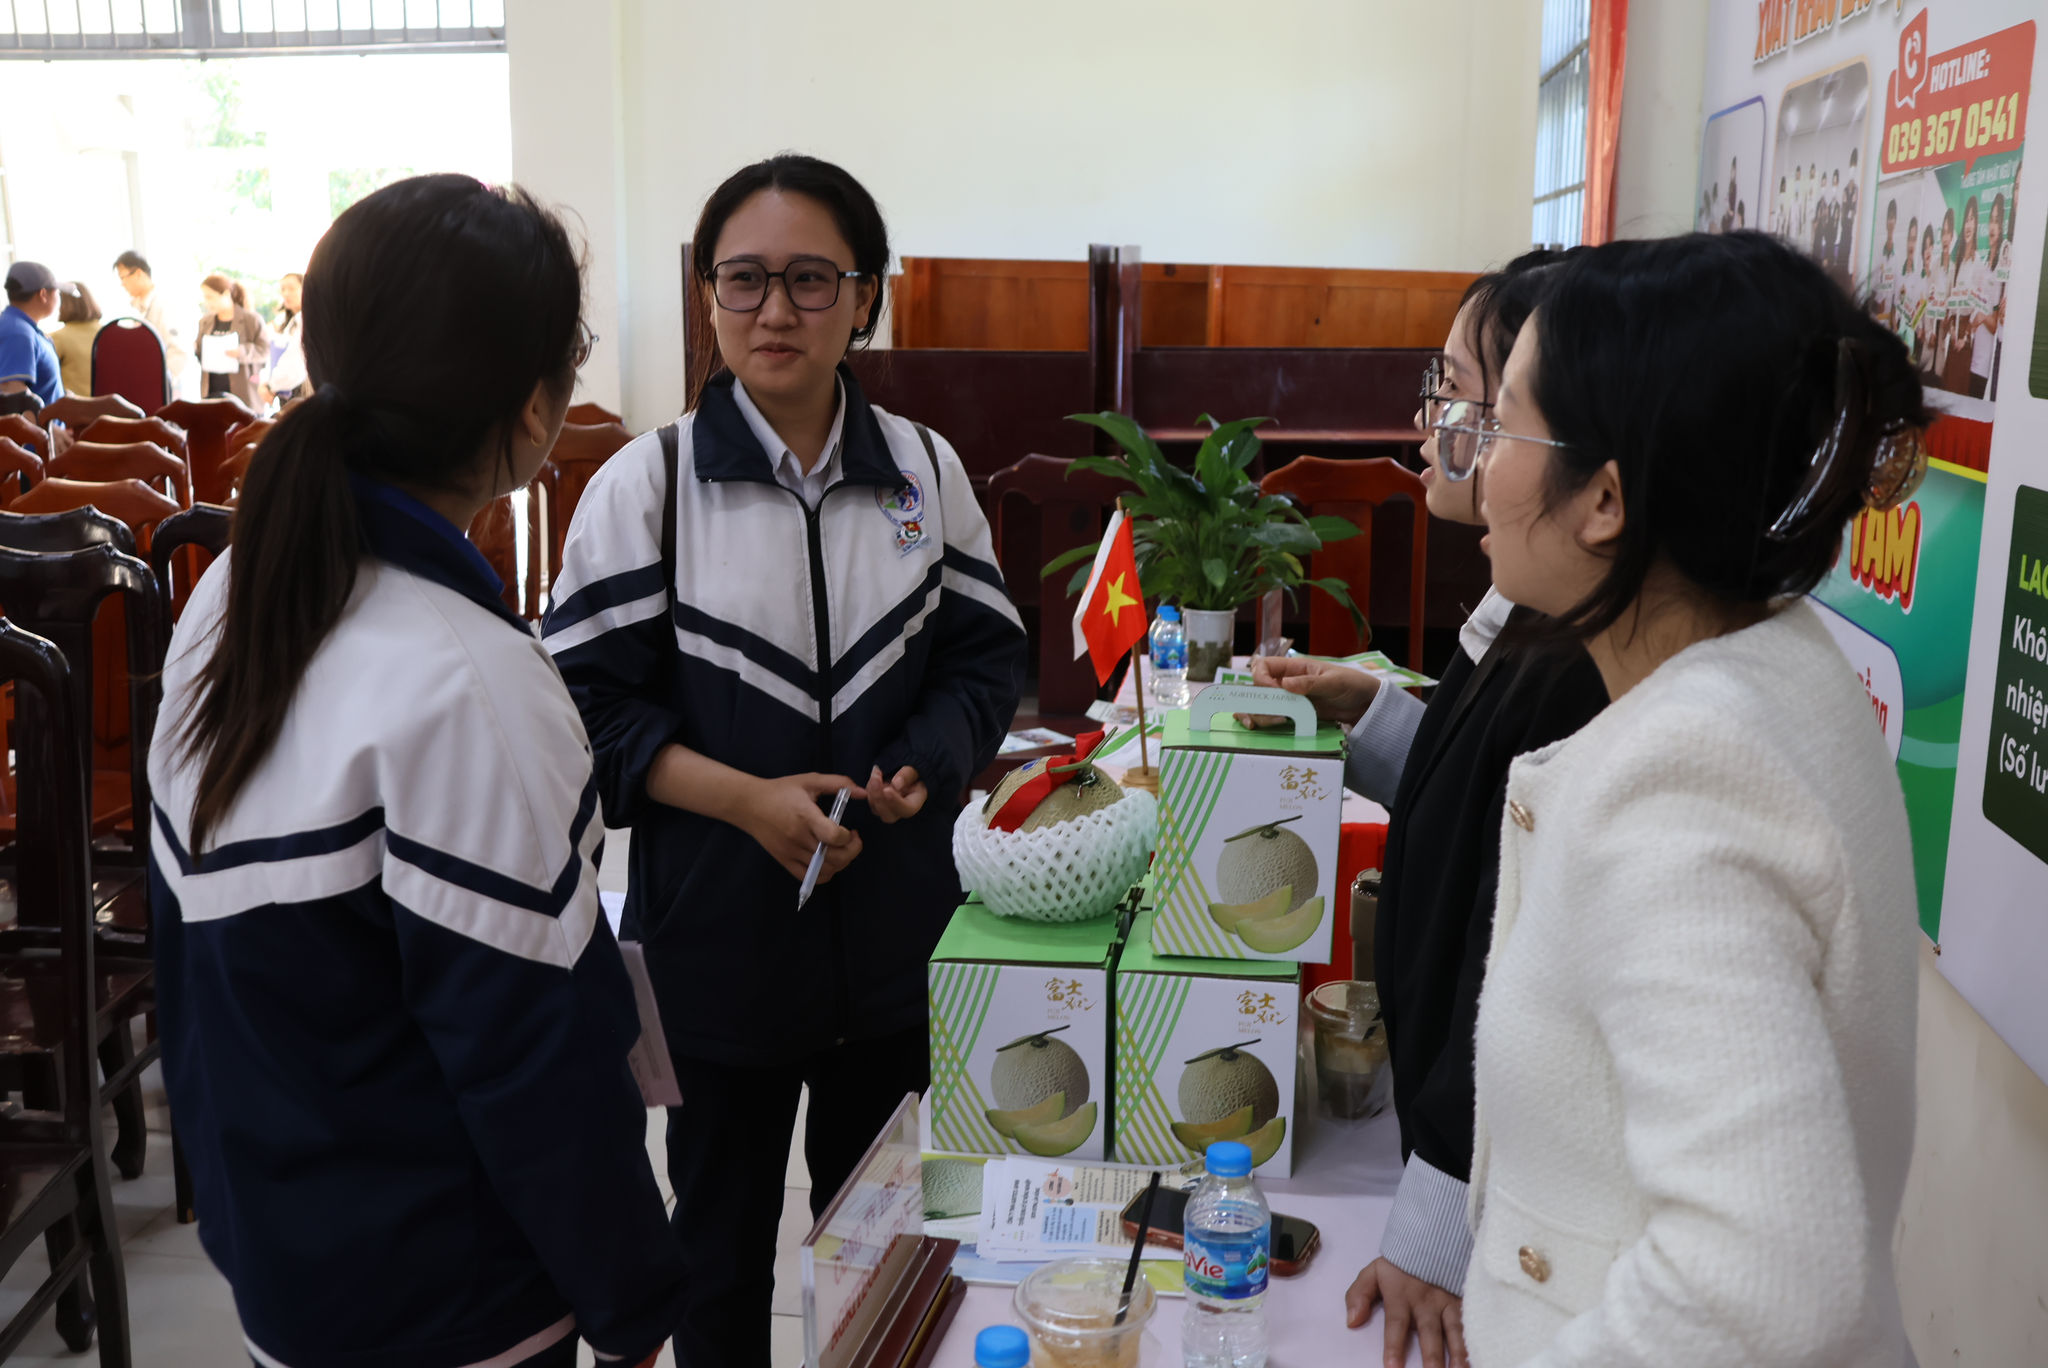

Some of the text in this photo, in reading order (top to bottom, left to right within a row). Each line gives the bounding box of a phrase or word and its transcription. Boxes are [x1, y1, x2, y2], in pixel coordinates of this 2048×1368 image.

[1930, 48, 1991, 94] HOTLINE:
[1887, 91, 2019, 165] 039 367 0541
[2012, 614, 2048, 665] Khô
[1999, 732, 2030, 779] (Số
[1184, 1249, 1224, 1279] aVie
